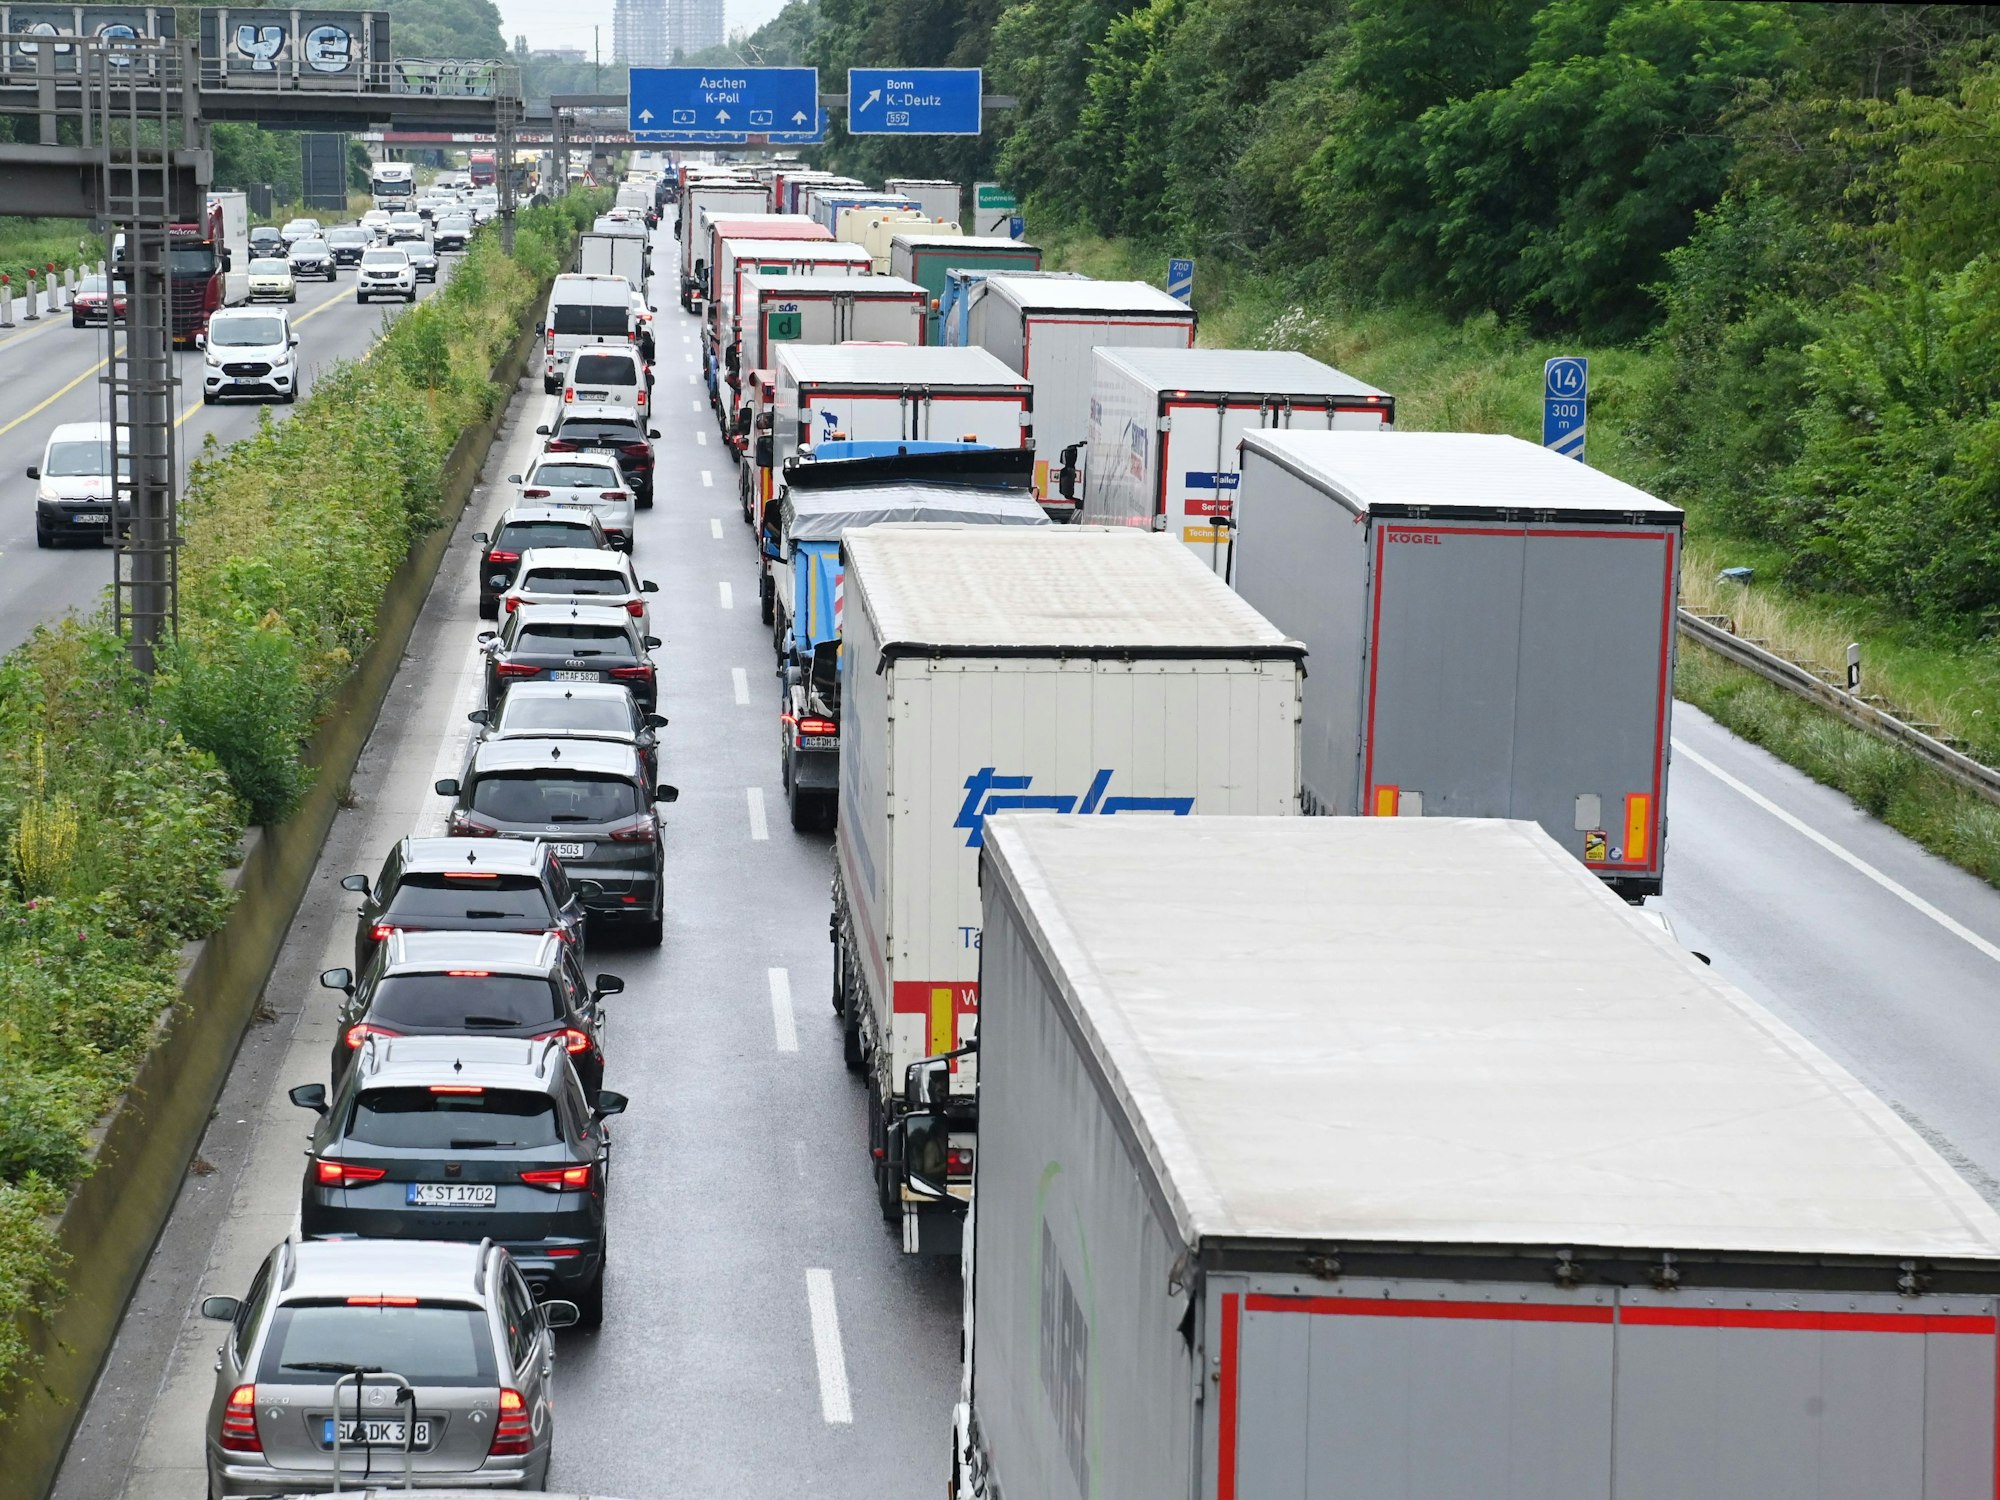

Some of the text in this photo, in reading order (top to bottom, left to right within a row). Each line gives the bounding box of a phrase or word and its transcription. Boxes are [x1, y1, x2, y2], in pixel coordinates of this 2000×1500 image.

[700, 77, 746, 89] Aachen
[887, 80, 914, 90] Bonn
[705, 93, 740, 103] K-Poll
[680, 113, 687, 121] 4
[757, 113, 764, 122] 4
[889, 114, 906, 123] 559
[1173, 262, 1189, 271] 200
[1555, 368, 1577, 389] 14
[1552, 404, 1578, 417] 300
[1558, 420, 1570, 429] m
[1211, 476, 1237, 484] Tailer
[555, 671, 565, 680] BM
[570, 672, 578, 680] AF
[560, 844, 579, 854] 503
[416, 1186, 493, 1201] K ST 1702
[369, 1424, 391, 1441] DK
[395, 1424, 427, 1441] 38
